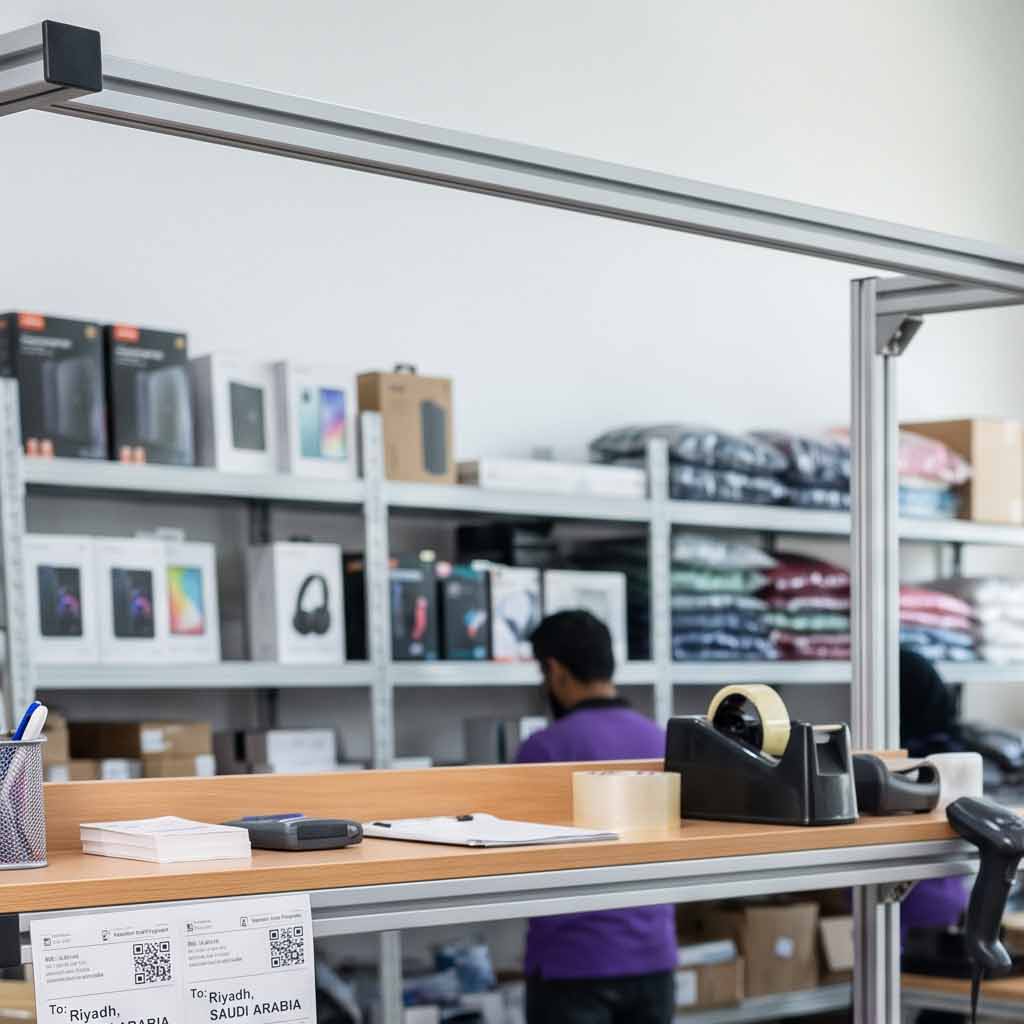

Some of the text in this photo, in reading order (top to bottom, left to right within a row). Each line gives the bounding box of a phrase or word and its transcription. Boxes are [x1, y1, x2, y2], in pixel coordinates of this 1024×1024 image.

[190, 988, 254, 1005] To: Riyadh,
[49, 1004, 120, 1023] To: Riyadh,
[210, 999, 302, 1021] SAUDI ARABIA
